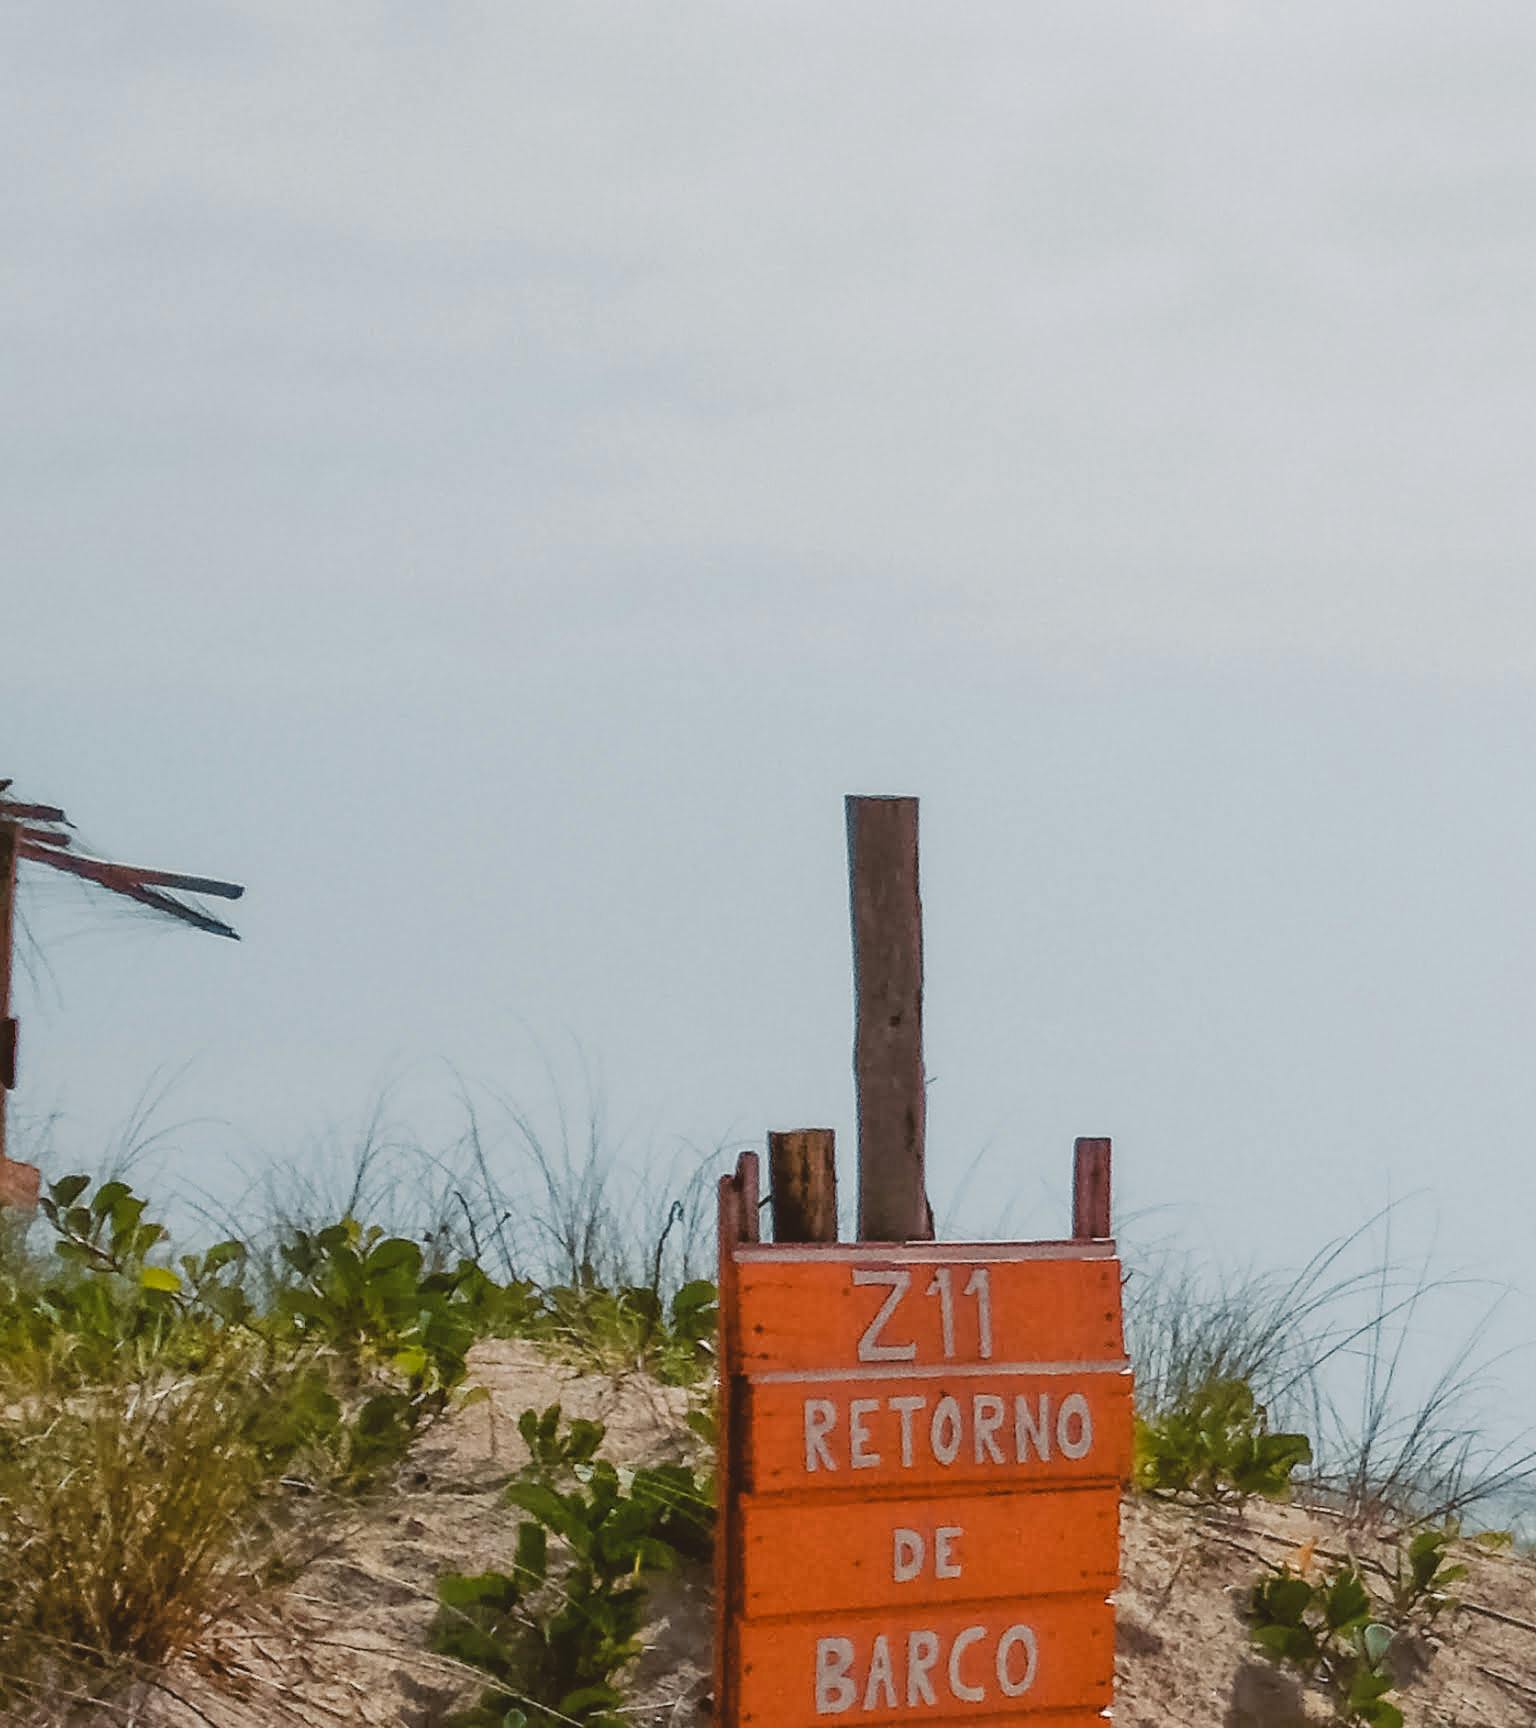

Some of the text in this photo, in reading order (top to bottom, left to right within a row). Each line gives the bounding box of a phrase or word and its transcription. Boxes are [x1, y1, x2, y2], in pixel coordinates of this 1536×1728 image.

[852, 1267, 993, 1363] Z11
[804, 1392, 1093, 1472] RETORNO
[893, 1527, 963, 1582] DE
[815, 1624, 1037, 1714] BARCO
